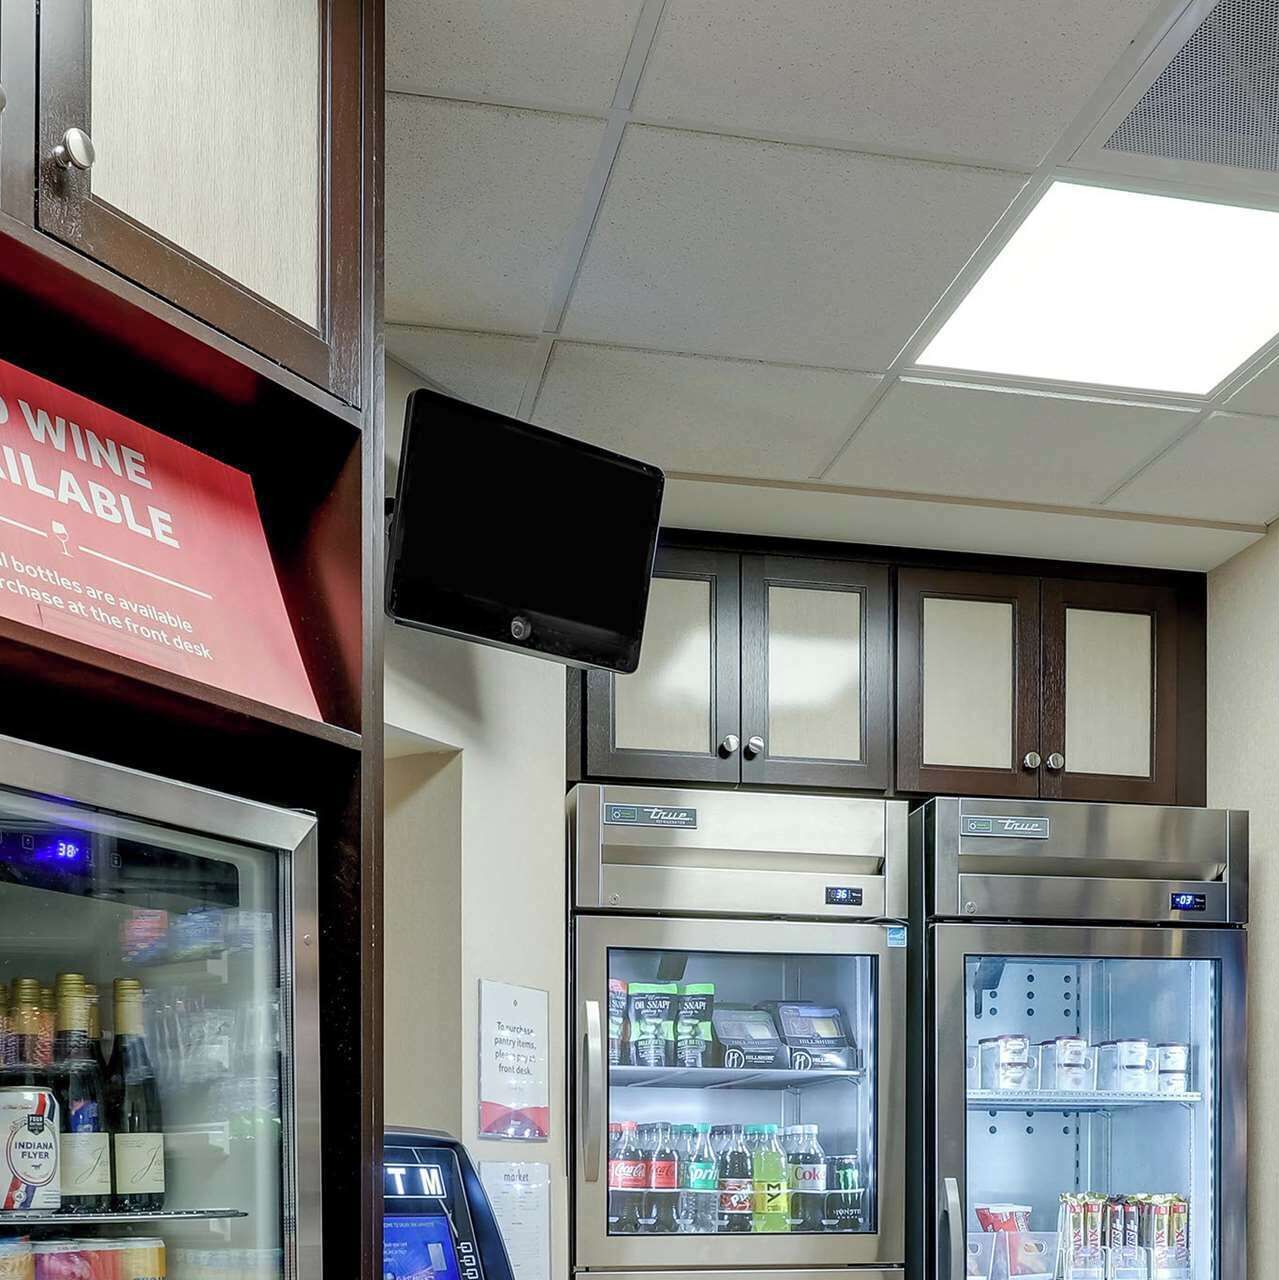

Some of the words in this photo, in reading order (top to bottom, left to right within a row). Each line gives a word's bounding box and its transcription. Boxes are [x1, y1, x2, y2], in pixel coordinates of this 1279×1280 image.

[17, 399, 153, 490] WINE
[13, 553, 84, 595] bottles
[86, 582, 116, 607] are
[119, 591, 194, 633] available
[68, 596, 88, 617] at
[91, 602, 123, 630] the
[125, 617, 170, 647] front
[172, 634, 214, 661] desk
[643, 808, 694, 821] true
[997, 819, 1042, 831] true
[496, 1021, 505, 1030] To
[506, 1025, 534, 1035] urchase
[494, 1037, 516, 1049] pantry
[499, 1063, 515, 1073] front
[14, 1142, 54, 1150] INDIANA
[21, 1151, 49, 1160] FLYER
[386, 1167, 443, 1195] TM
[503, 1169, 529, 1183] market
